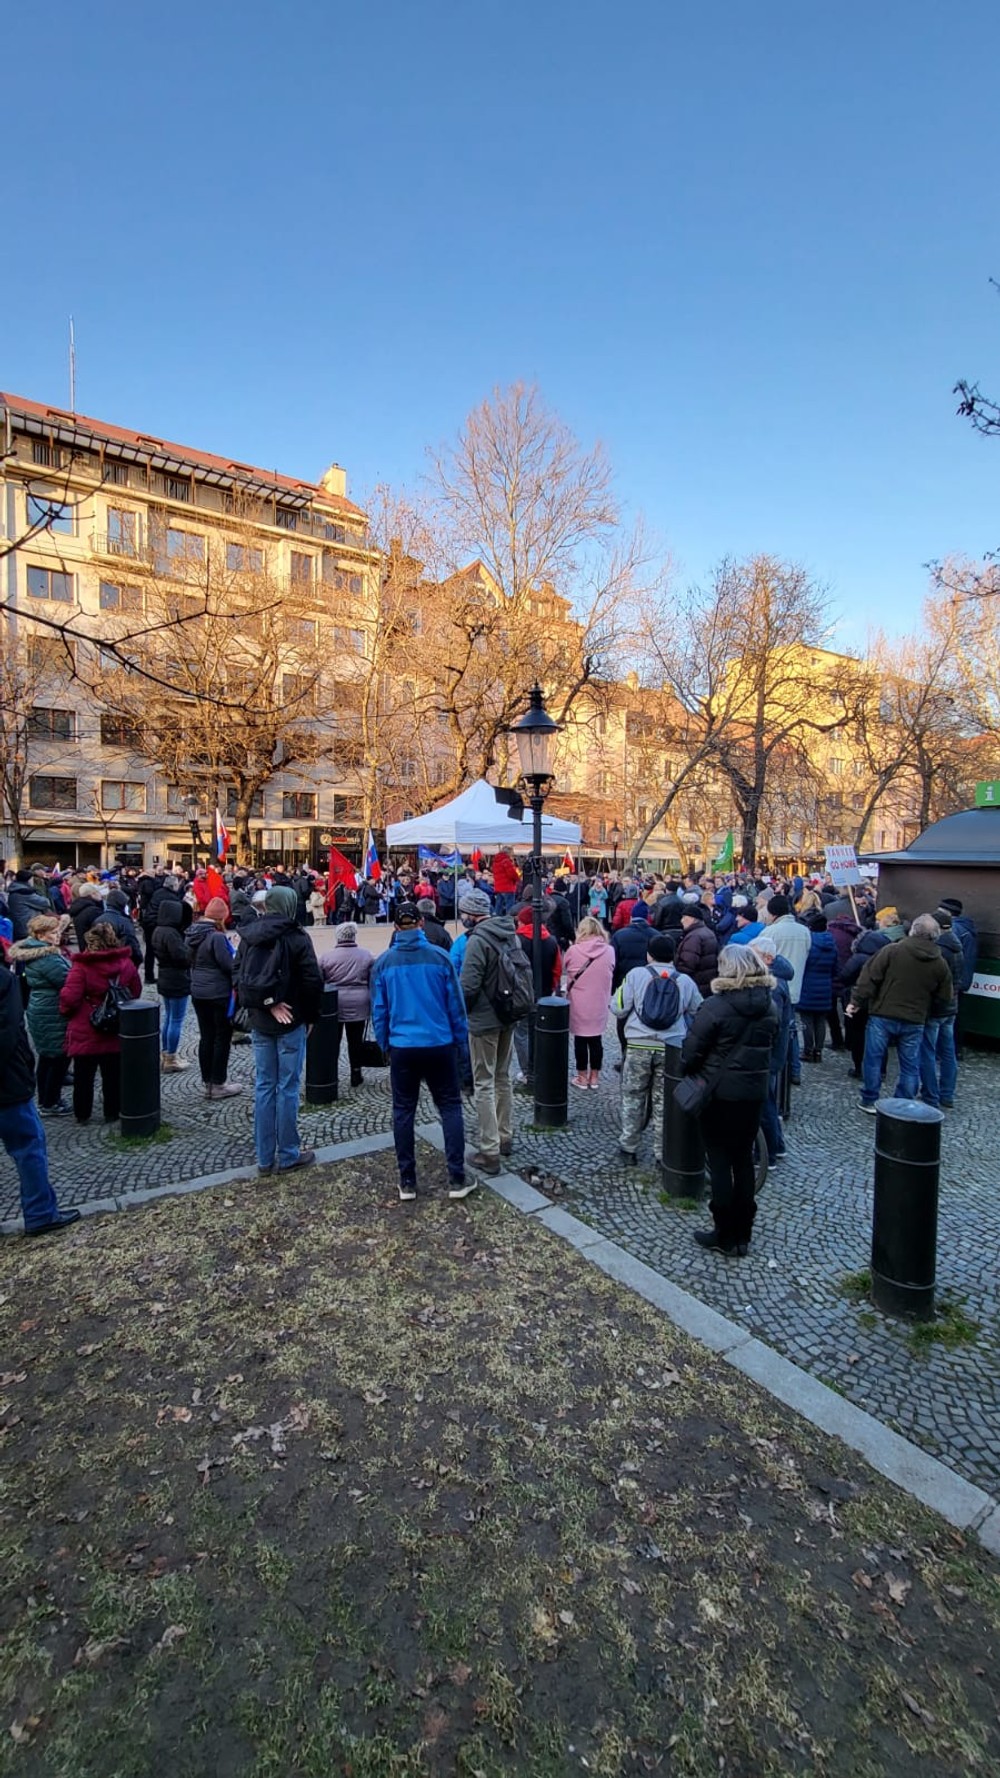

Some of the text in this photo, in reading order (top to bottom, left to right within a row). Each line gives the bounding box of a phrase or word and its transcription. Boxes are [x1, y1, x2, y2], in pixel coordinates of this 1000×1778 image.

[985, 786, 994, 800] i
[831, 860, 857, 870] GO HOME
